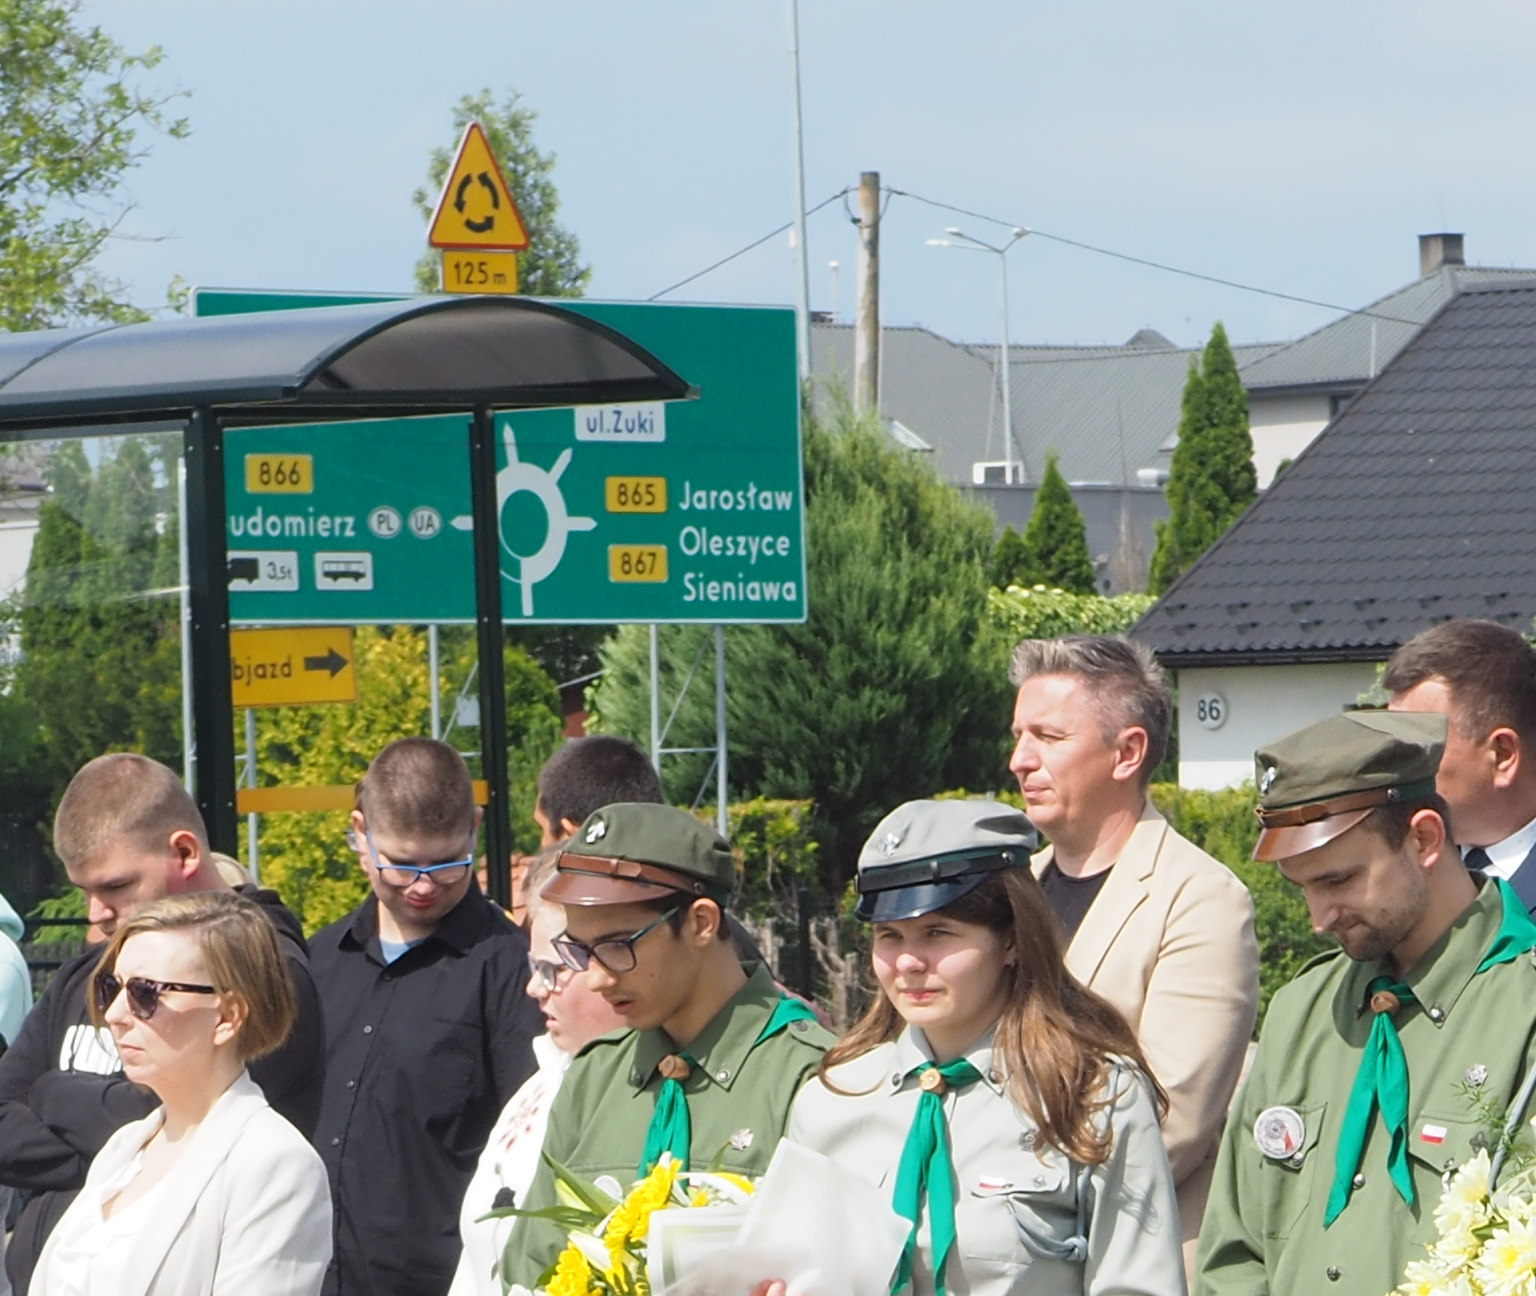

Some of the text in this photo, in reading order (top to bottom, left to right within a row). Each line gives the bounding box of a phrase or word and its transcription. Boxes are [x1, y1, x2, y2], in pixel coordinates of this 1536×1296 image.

[453, 260, 507, 285] 125 m
[258, 461, 301, 486] 866
[617, 483, 656, 507] 865
[678, 480, 794, 511] Jarosław
[229, 506, 437, 537] udomierz PL UA
[678, 525, 791, 565] Oleszyce
[266, 561, 293, 582] 3,5t
[620, 551, 658, 575] 867
[682, 571, 798, 602] Sieniawa
[231, 654, 293, 687] bjazd
[1197, 698, 1221, 722] 86
[59, 1024, 122, 1076] PUM
